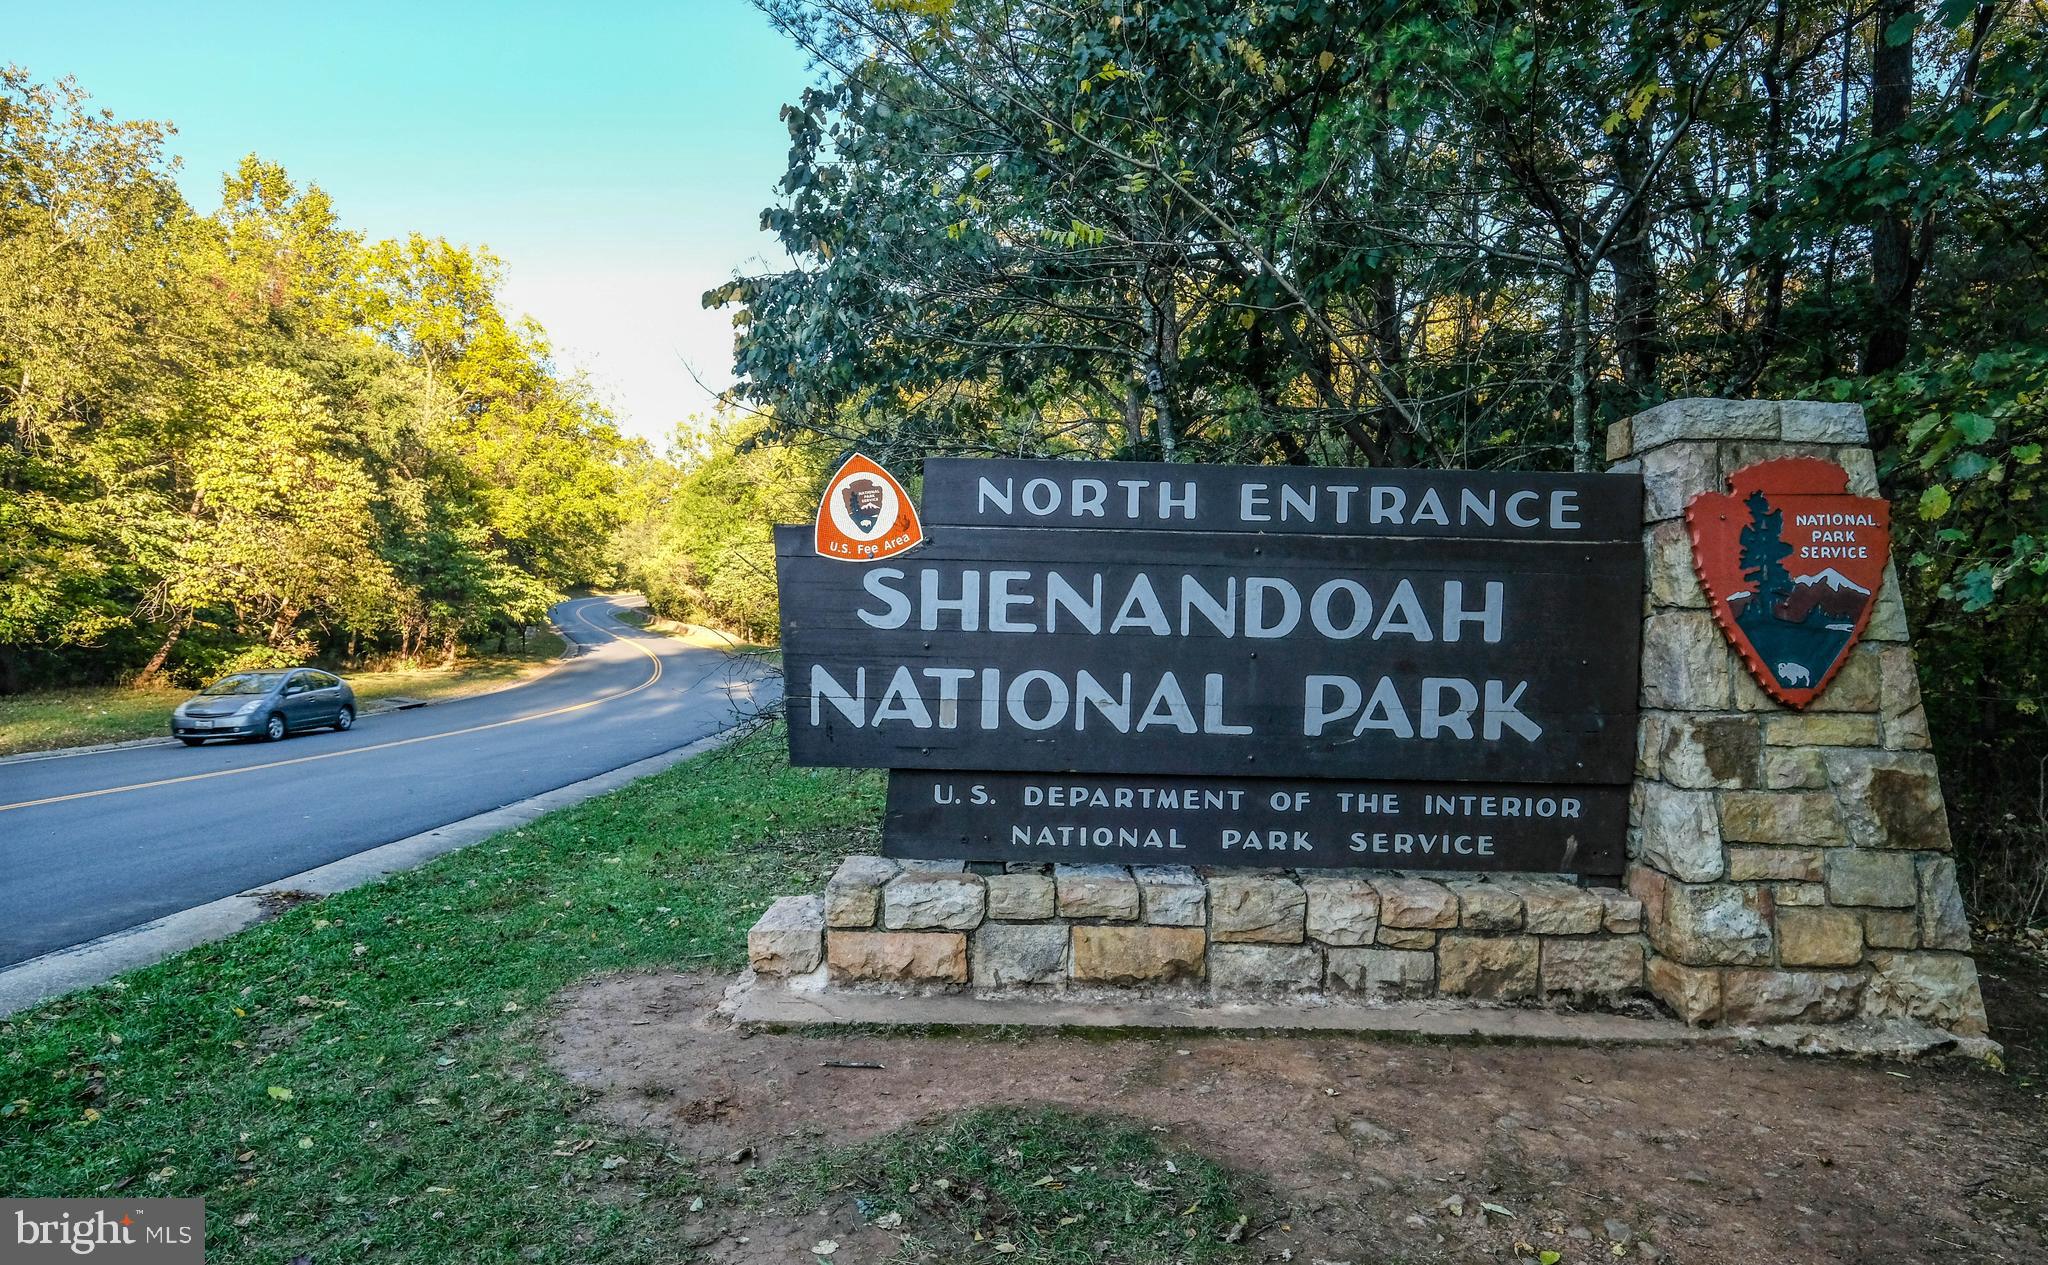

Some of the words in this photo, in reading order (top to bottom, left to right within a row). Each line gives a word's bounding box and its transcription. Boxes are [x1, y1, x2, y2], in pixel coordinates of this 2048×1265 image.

[978, 476, 1197, 520] NORTH
[1240, 483, 1582, 529] ENTRANCE
[1796, 513, 1876, 527] NATIONAL
[829, 541, 852, 555] U.S.
[857, 544, 879, 554] Fee
[884, 533, 910, 551] Area
[1811, 530, 1856, 543] PARK
[1799, 546, 1868, 559] SERVICE
[856, 567, 1504, 643] SHENANDOAH
[809, 664, 1254, 735] NATIONAL
[1303, 674, 1543, 743] PARK
[1024, 786, 1245, 811] DEPARTMENT
[1269, 791, 1311, 812] OF
[1336, 792, 1400, 814] THE
[1424, 794, 1581, 819] INTERIOR
[1011, 825, 1187, 849] NATIONAL
[1221, 829, 1314, 852] PARK
[1348, 832, 1495, 856] SERVICE
